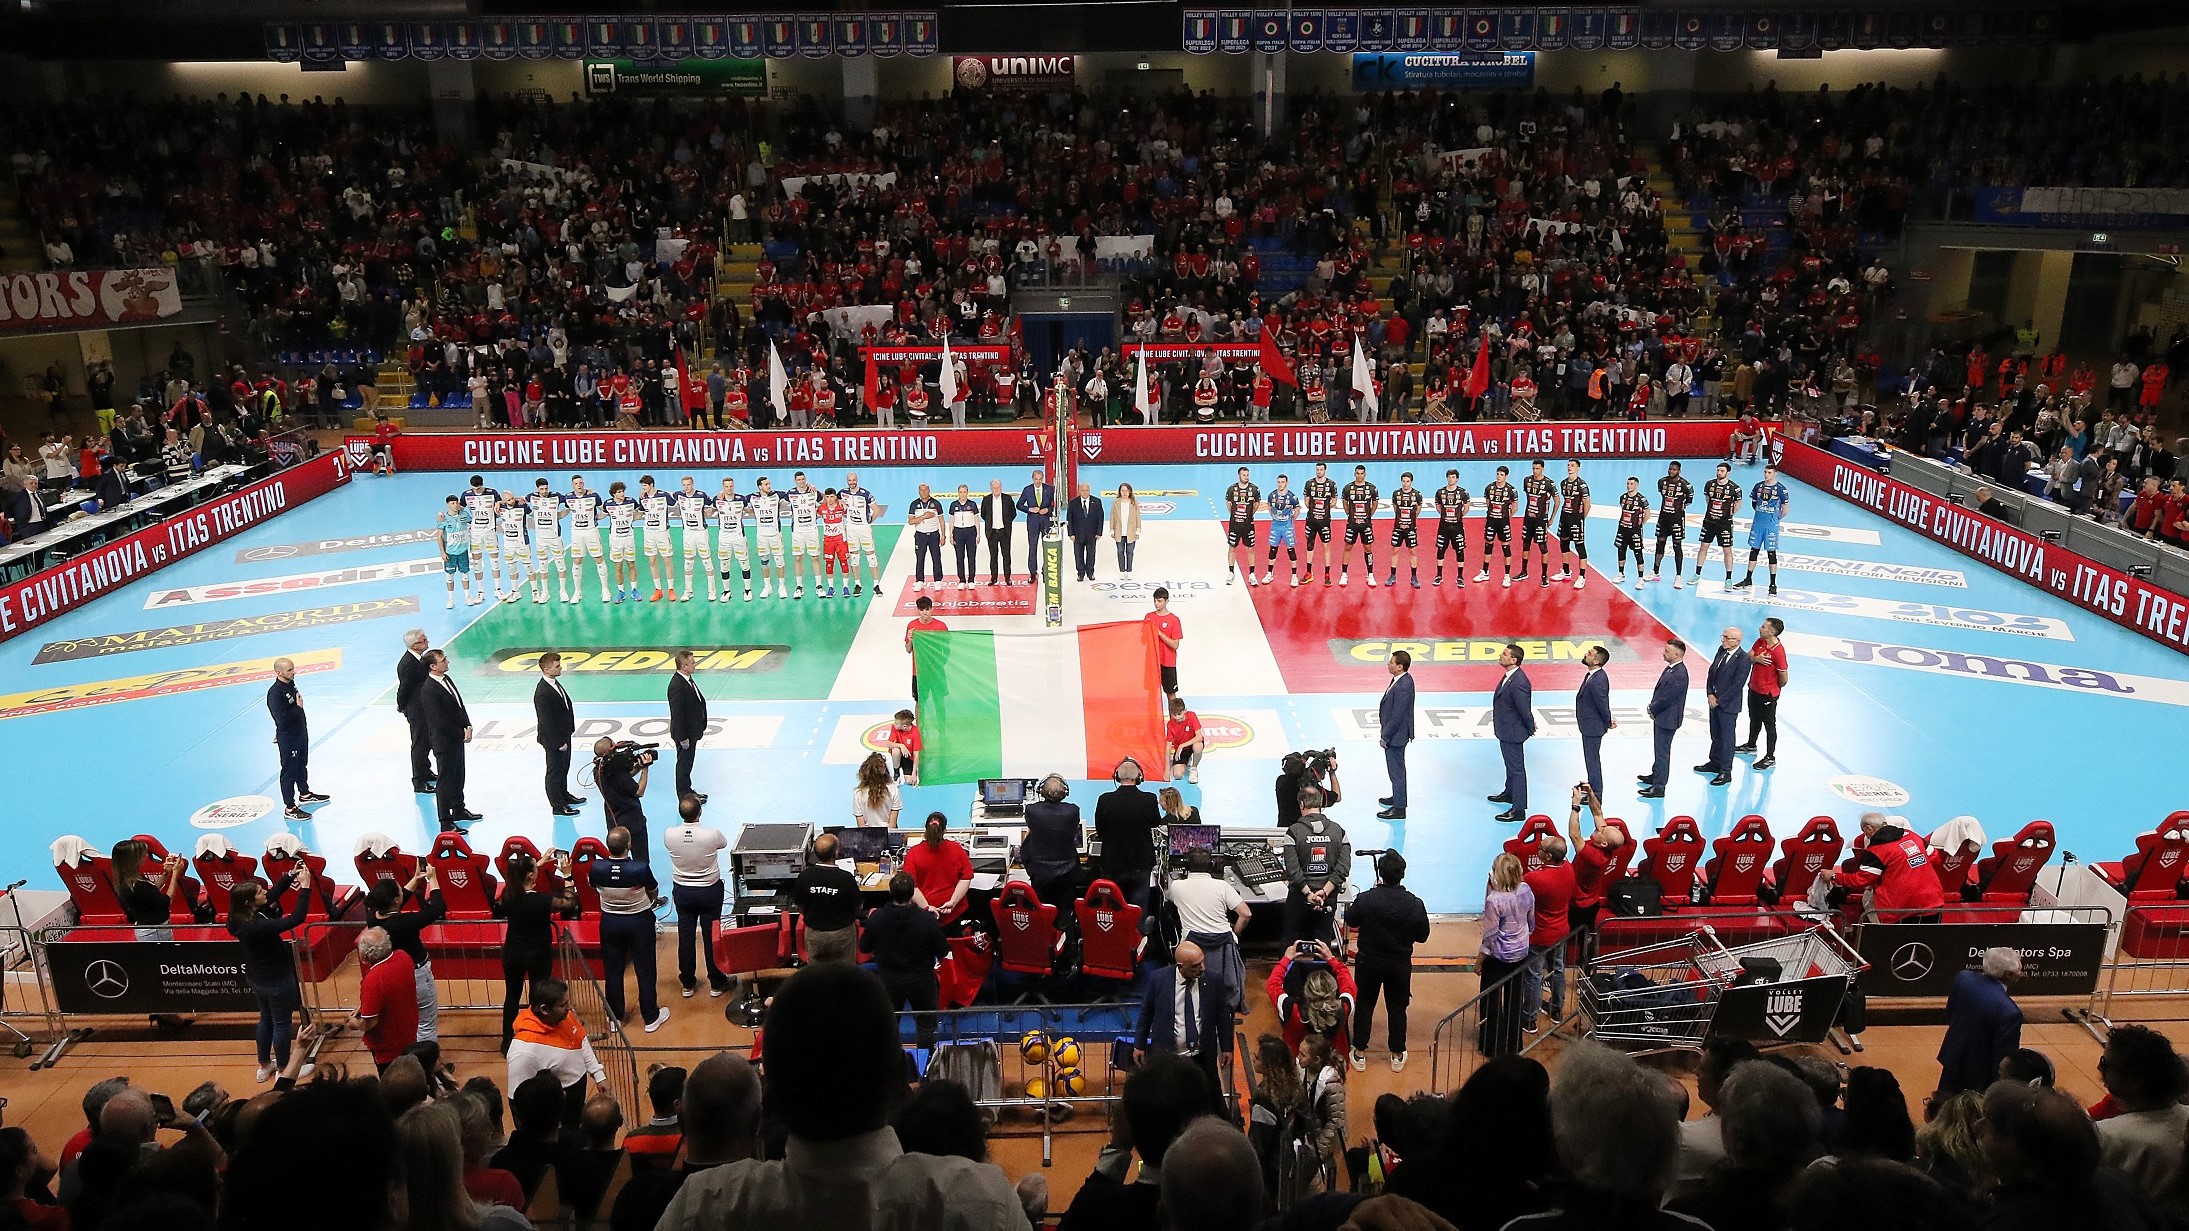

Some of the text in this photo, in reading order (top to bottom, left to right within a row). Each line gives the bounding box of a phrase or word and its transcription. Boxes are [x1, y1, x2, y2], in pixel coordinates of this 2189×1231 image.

[1405, 56, 1469, 67] CUCITUR
[593, 74, 612, 83] TWS
[617, 73, 701, 85] Trans World Shipping
[891, 352, 907, 361] LUBE
[969, 352, 999, 361] TRENTINO
[1155, 350, 1171, 358] LUBE
[1082, 435, 1102, 446] LUBE
[1196, 433, 1274, 457] CUCINE
[1283, 432, 1336, 456] LUBE
[1345, 430, 1475, 456] CIVITANOVA
[1506, 429, 1553, 454] ITAS
[1560, 428, 1666, 453] TRENTINO
[465, 440, 544, 465] CUCINE
[553, 439, 606, 464] LUBE
[614, 438, 746, 464] CIVITANOVA
[776, 437, 824, 462] ITAS
[831, 436, 937, 461] TRENTINO
[319, 529, 439, 550] DeltaM
[1833, 464, 1886, 515] CUCINE
[1888, 486, 1928, 530] LUBE
[1933, 501, 2044, 581] CIVITANOVA
[2072, 563, 2128, 616] ITAS
[21, 539, 148, 622] CIVITANOVA
[168, 514, 210, 556] ITAS
[211, 481, 287, 535] TRENTINO
[1047, 547, 1058, 588] BANCA
[1874, 564, 1958, 581] Nello
[1779, 563, 1963, 587] USATI TRATTORI REVISIONI
[1119, 580, 1214, 591] estra
[1742, 597, 1825, 611] SCATOLIFICIO
[102, 598, 413, 647] MALAGRIDA
[1349, 641, 1605, 662] CREDEM
[56, 696, 126, 707] PICENA
[157, 662, 331, 695] arredamnti
[1202, 725, 1242, 737] nte
[1312, 854, 1325, 862] LUBE
[1667, 855, 1686, 864] LUBE
[1736, 855, 1755, 865] LUBE
[1805, 855, 1824, 864] LUBE
[2162, 851, 2181, 859] LUBE
[214, 874, 234, 882] LUBE
[448, 871, 468, 879] LUBE
[809, 886, 839, 896] STAFF
[1012, 913, 1029, 923] LUBE
[1096, 912, 1114, 923] LUBE
[2048, 947, 2072, 960] Spa
[159, 964, 238, 975] DeltaMotors
[222, 980, 237, 988] (MC)
[1766, 995, 1803, 1014] LUBE
